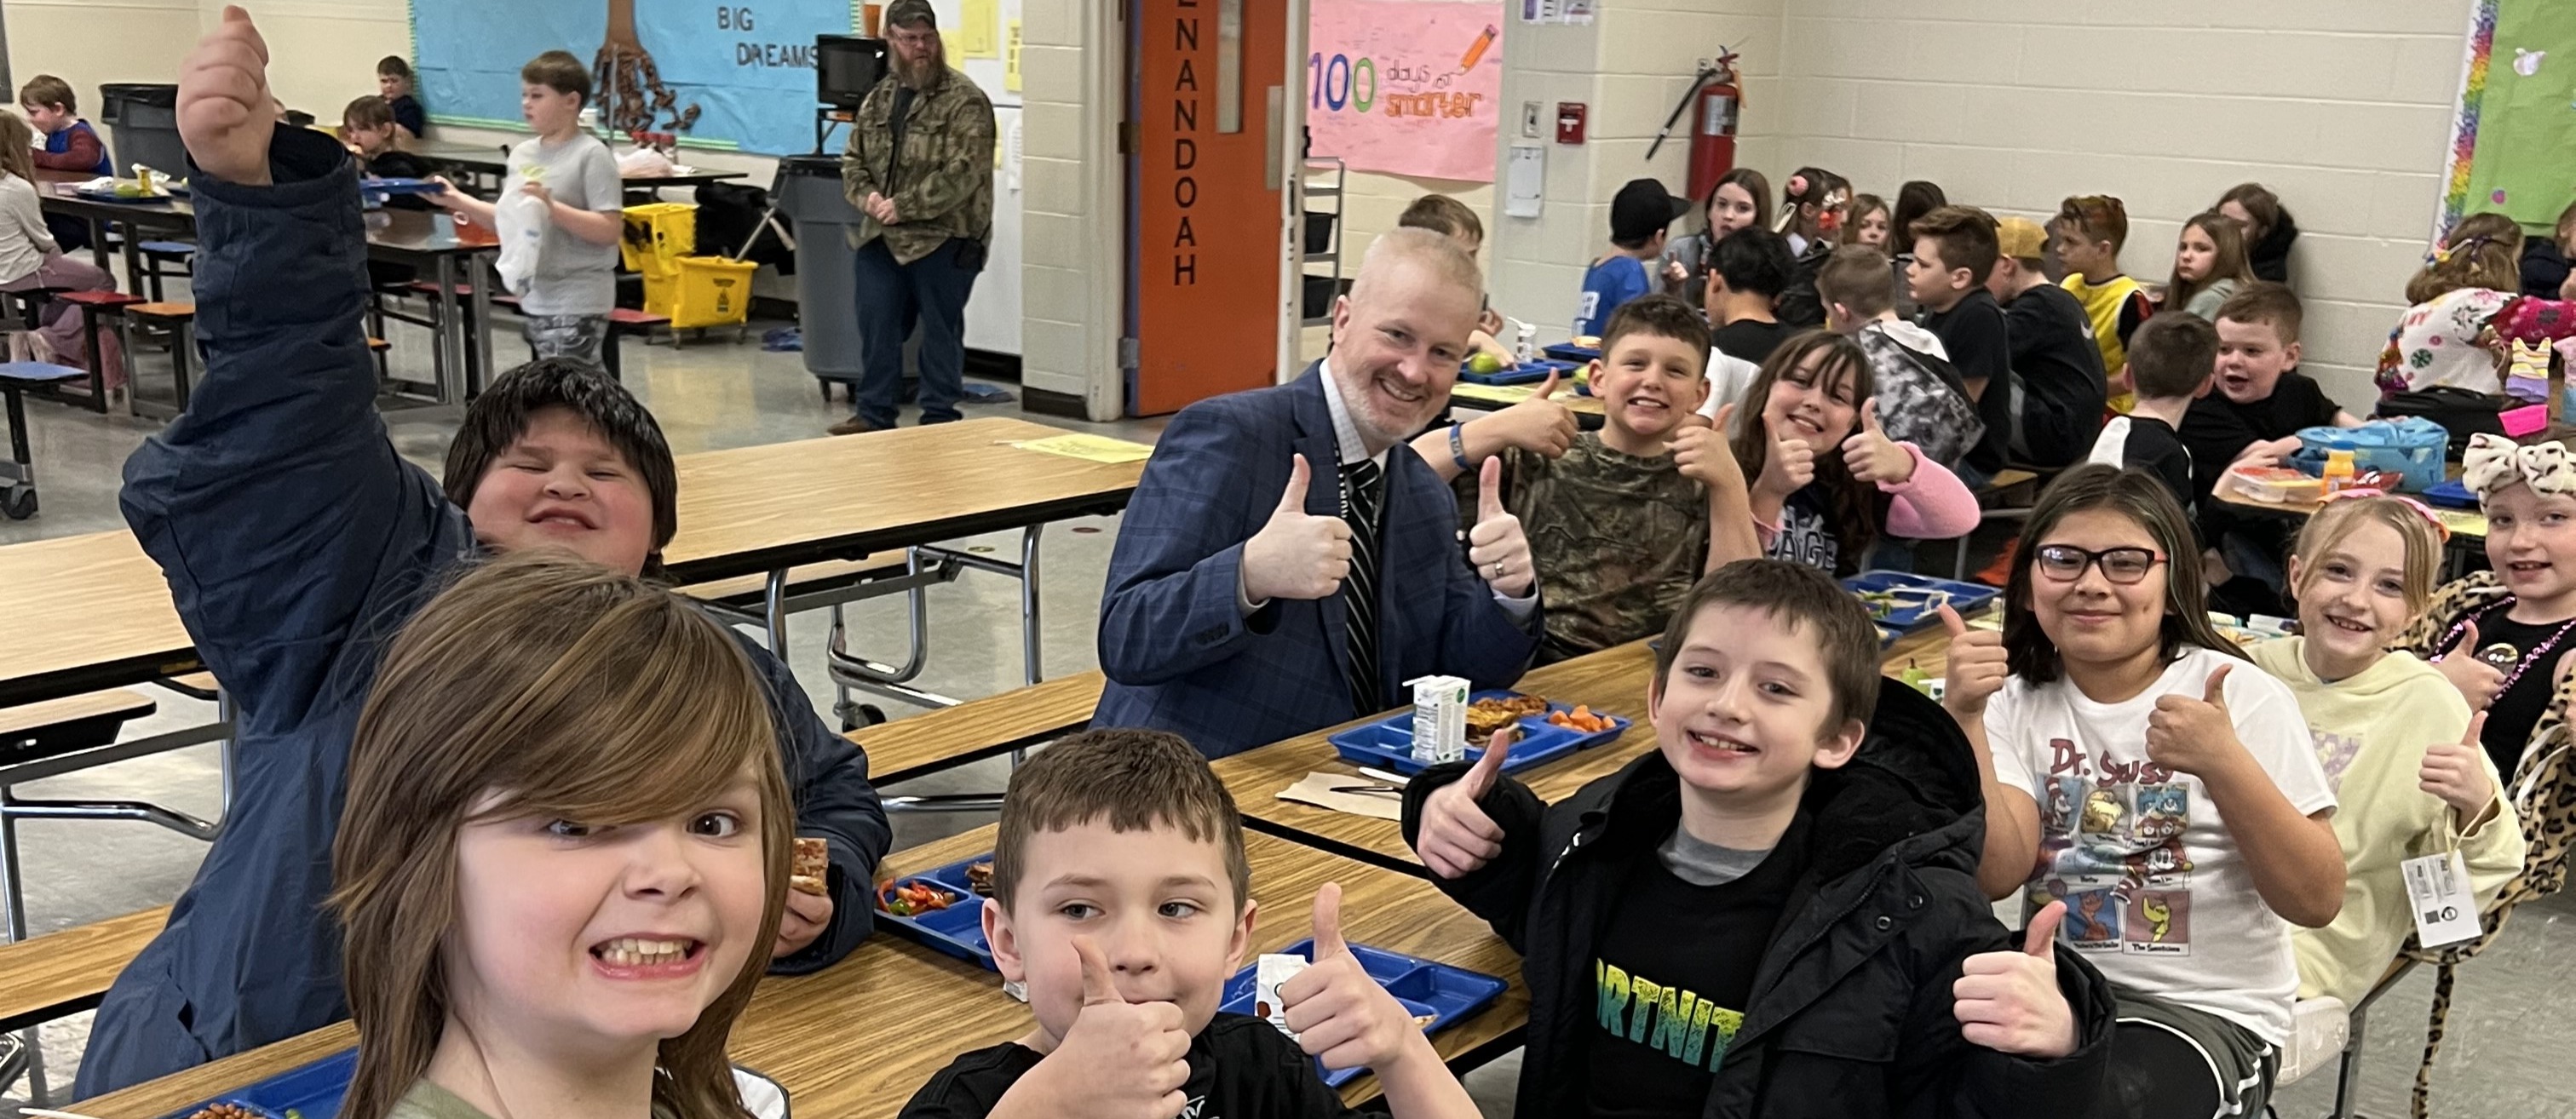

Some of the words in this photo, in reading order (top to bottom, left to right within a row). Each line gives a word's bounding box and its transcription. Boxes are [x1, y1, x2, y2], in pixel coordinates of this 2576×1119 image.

[717, 6, 754, 32] BIG
[736, 42, 819, 71] DREAMS
[1308, 52, 1375, 113] 100
[1385, 59, 1431, 94] days
[1383, 91, 1484, 118] smarter
[1173, 0, 1199, 286] NANDOAH
[2050, 737, 2091, 776] Dr.
[1596, 957, 1745, 1073] RTNIT
